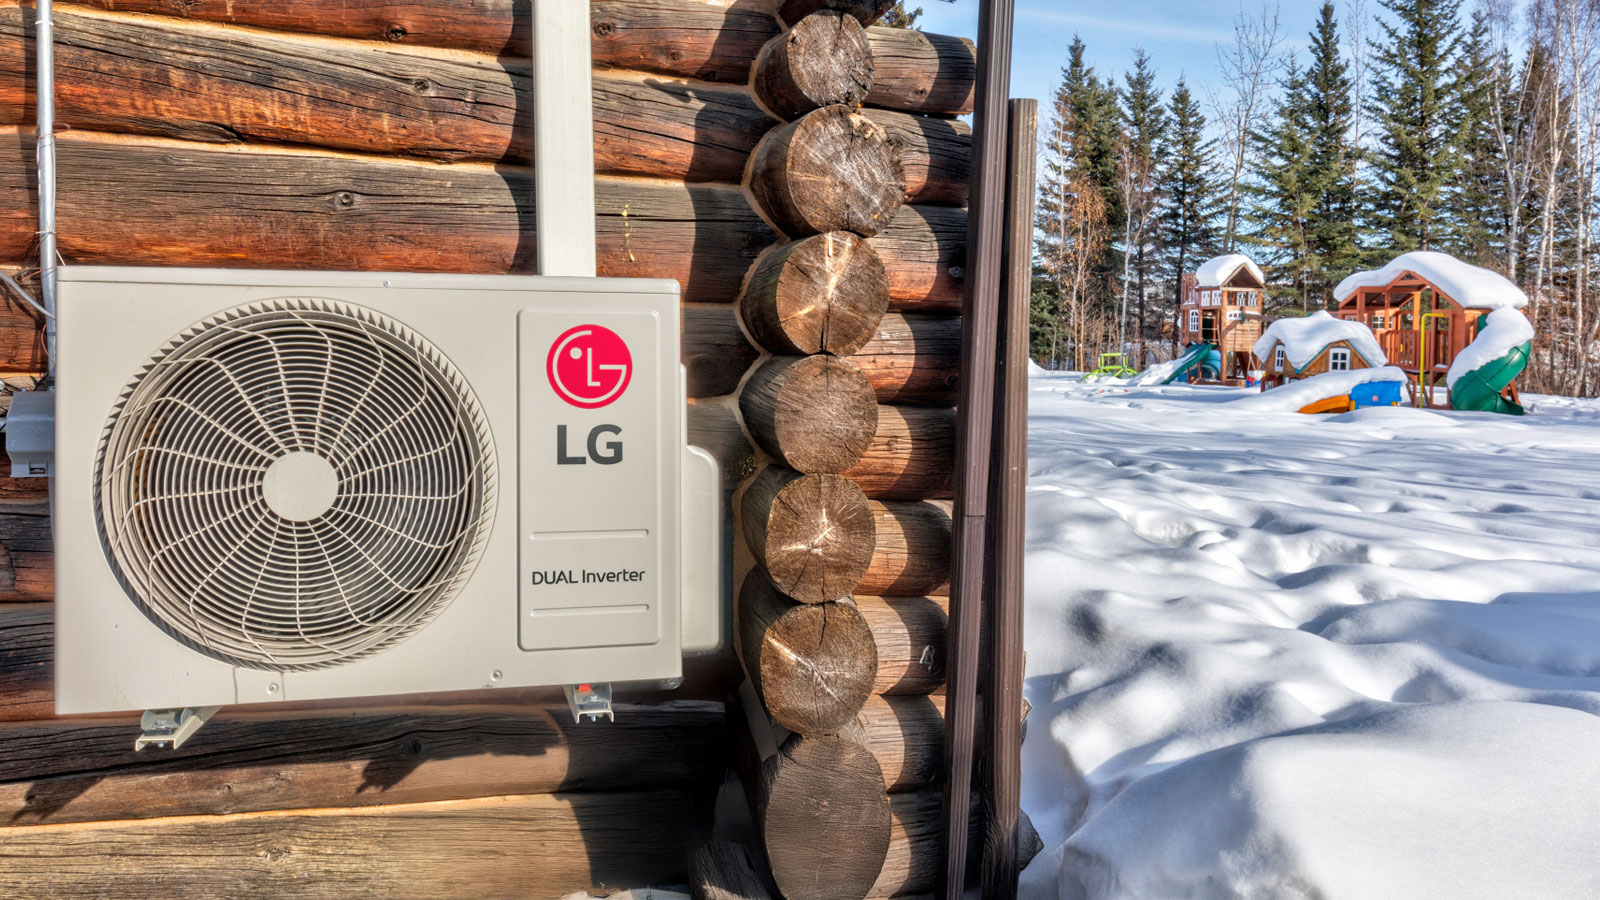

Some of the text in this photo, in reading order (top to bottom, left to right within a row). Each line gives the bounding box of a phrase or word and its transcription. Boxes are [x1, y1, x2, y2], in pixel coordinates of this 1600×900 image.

[551, 329, 628, 404] LG
[556, 423, 624, 465] LG
[531, 568, 646, 586] DUAL Inverter
